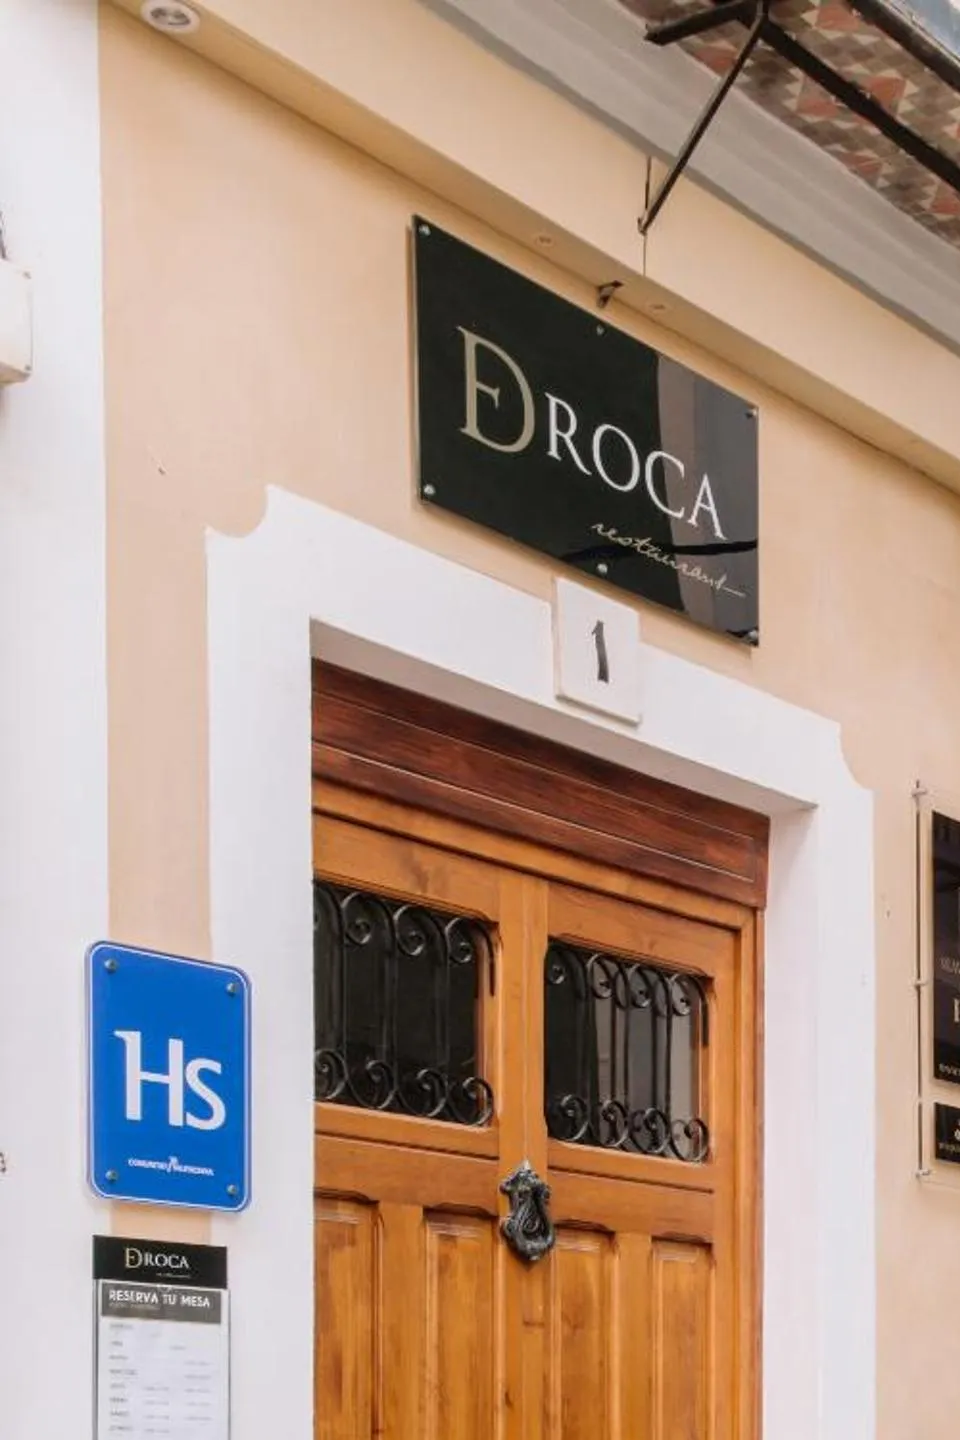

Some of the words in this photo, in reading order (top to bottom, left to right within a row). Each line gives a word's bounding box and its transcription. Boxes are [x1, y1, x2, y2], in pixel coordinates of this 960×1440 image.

[591, 619, 609, 684] 1
[108, 1289, 159, 1304] RESERVA
[162, 1294, 177, 1305] TU
[180, 1295, 210, 1308] MESA
